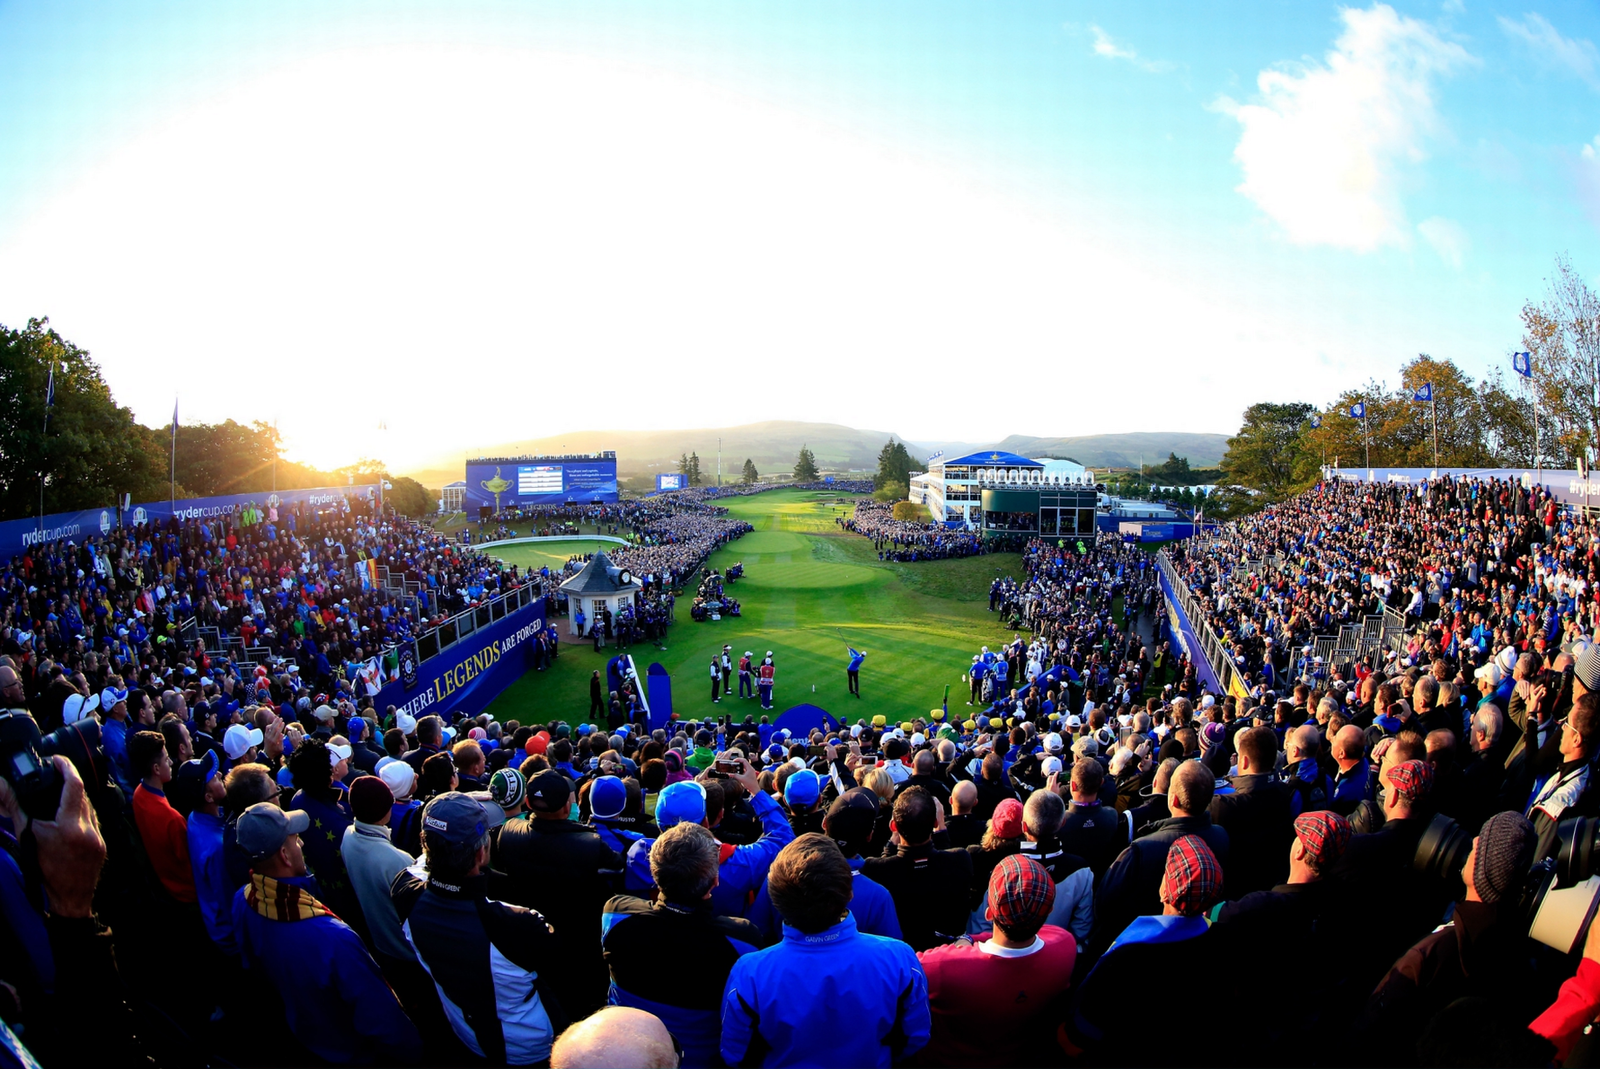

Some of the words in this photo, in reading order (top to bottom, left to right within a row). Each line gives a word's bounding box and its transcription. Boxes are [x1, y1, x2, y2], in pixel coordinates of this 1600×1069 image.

[309, 494, 344, 505] #rydercu
[22, 524, 80, 548] rydercup.com
[434, 640, 501, 703] LEGENDS
[501, 636, 516, 654] ARE
[516, 618, 542, 644] FORGED
